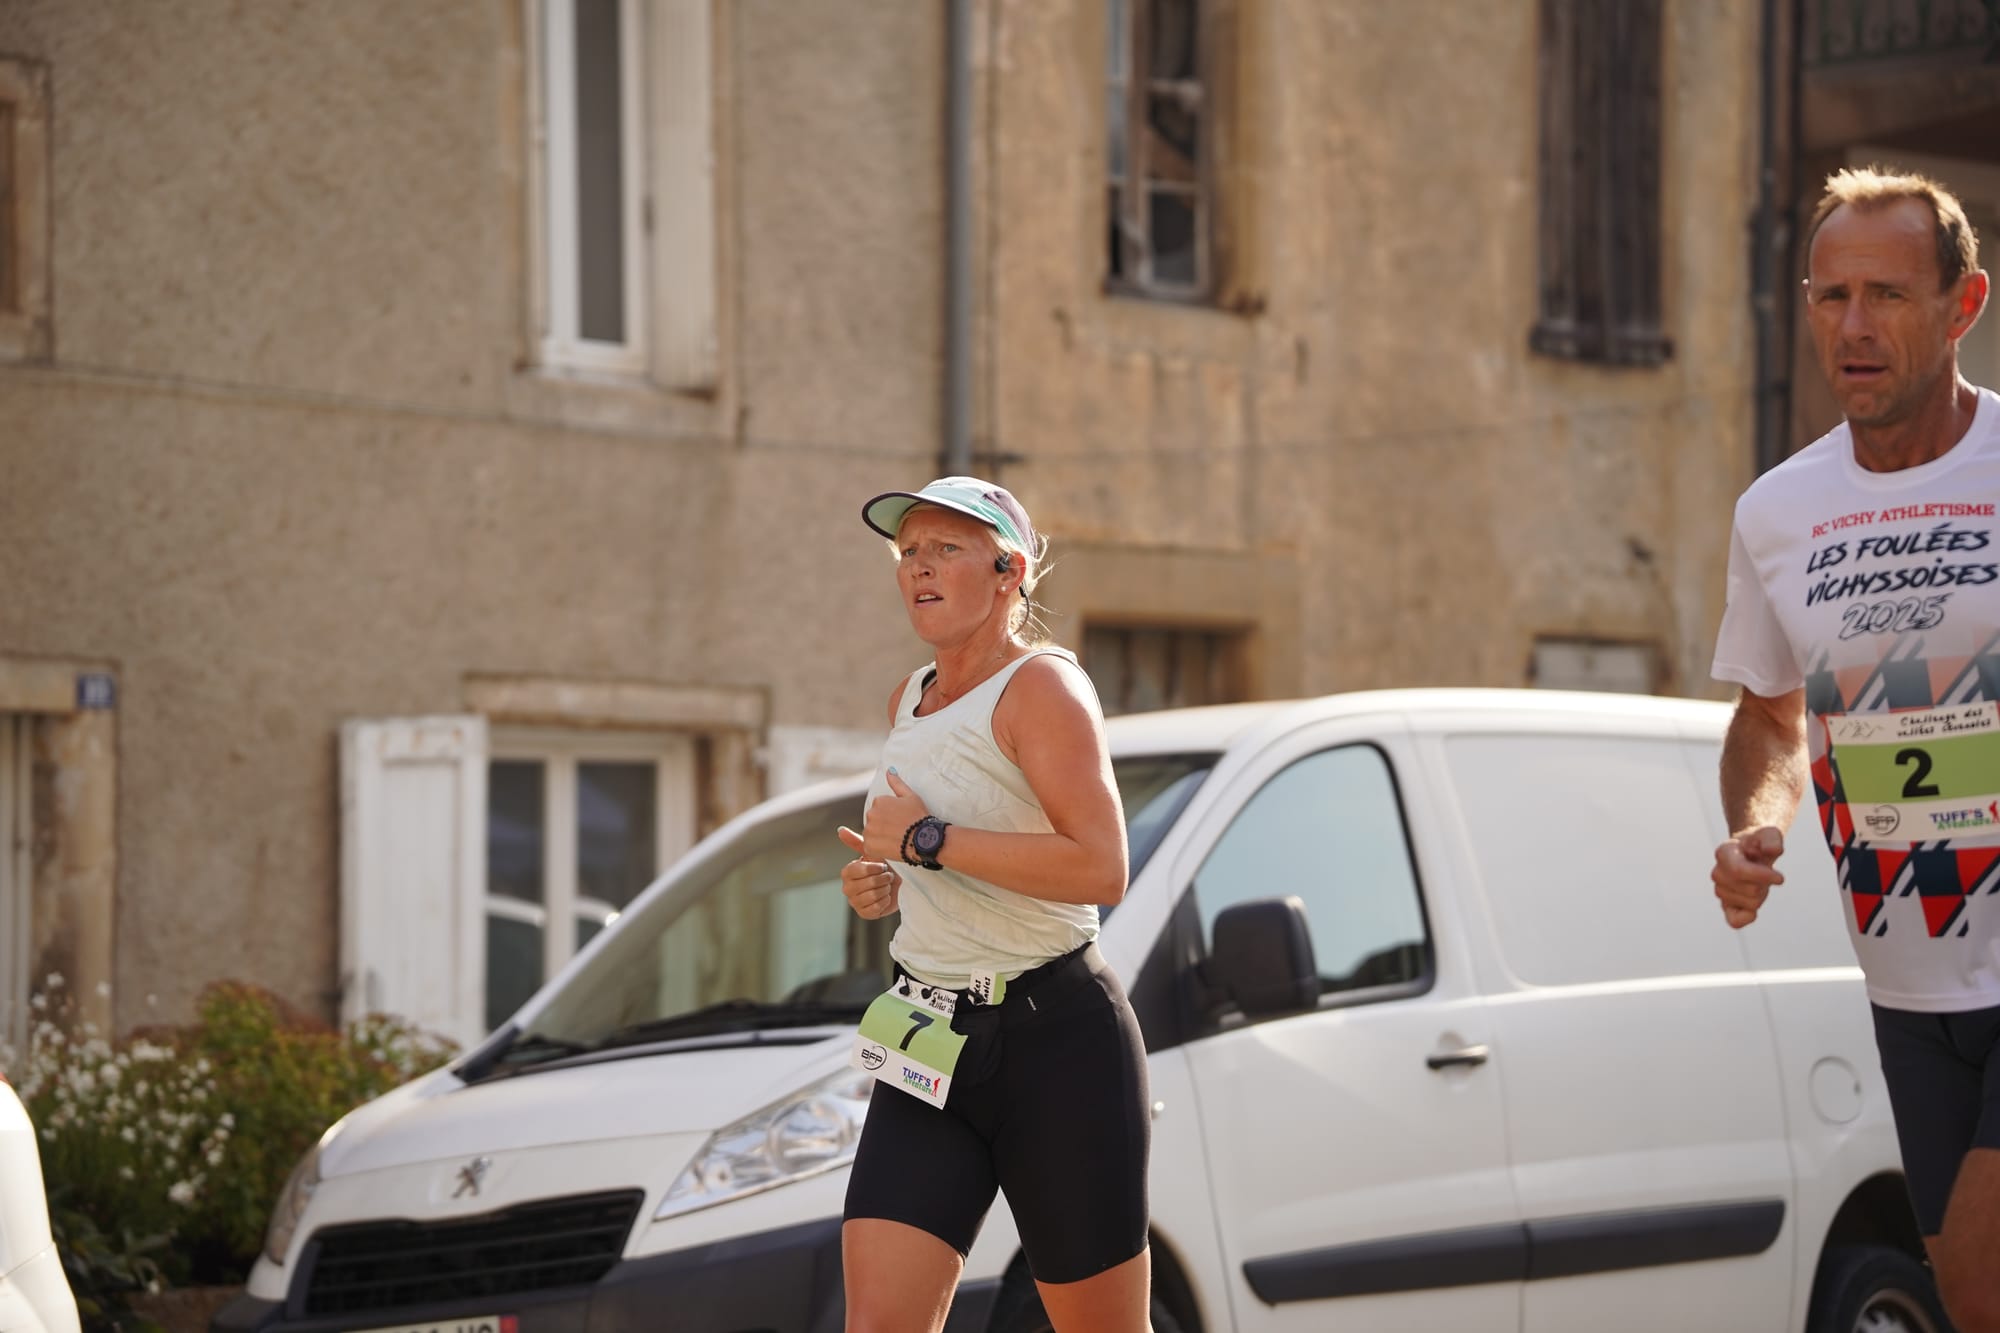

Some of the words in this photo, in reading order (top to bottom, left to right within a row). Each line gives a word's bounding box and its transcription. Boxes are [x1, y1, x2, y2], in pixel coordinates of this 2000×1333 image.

[1811, 522, 1830, 538] RC
[1832, 511, 1876, 531] VICHY
[1879, 503, 1996, 523] ATHLETISME
[1806, 541, 1848, 574] LES
[1855, 522, 1992, 562] FOULÉES
[1838, 592, 1954, 641] 2025
[1894, 747, 1940, 798] 2
[1929, 808, 1984, 824] TUFF'S
[899, 1010, 935, 1052] 7
[861, 1048, 883, 1063] BFP
[903, 1067, 931, 1087] TUFF'S
